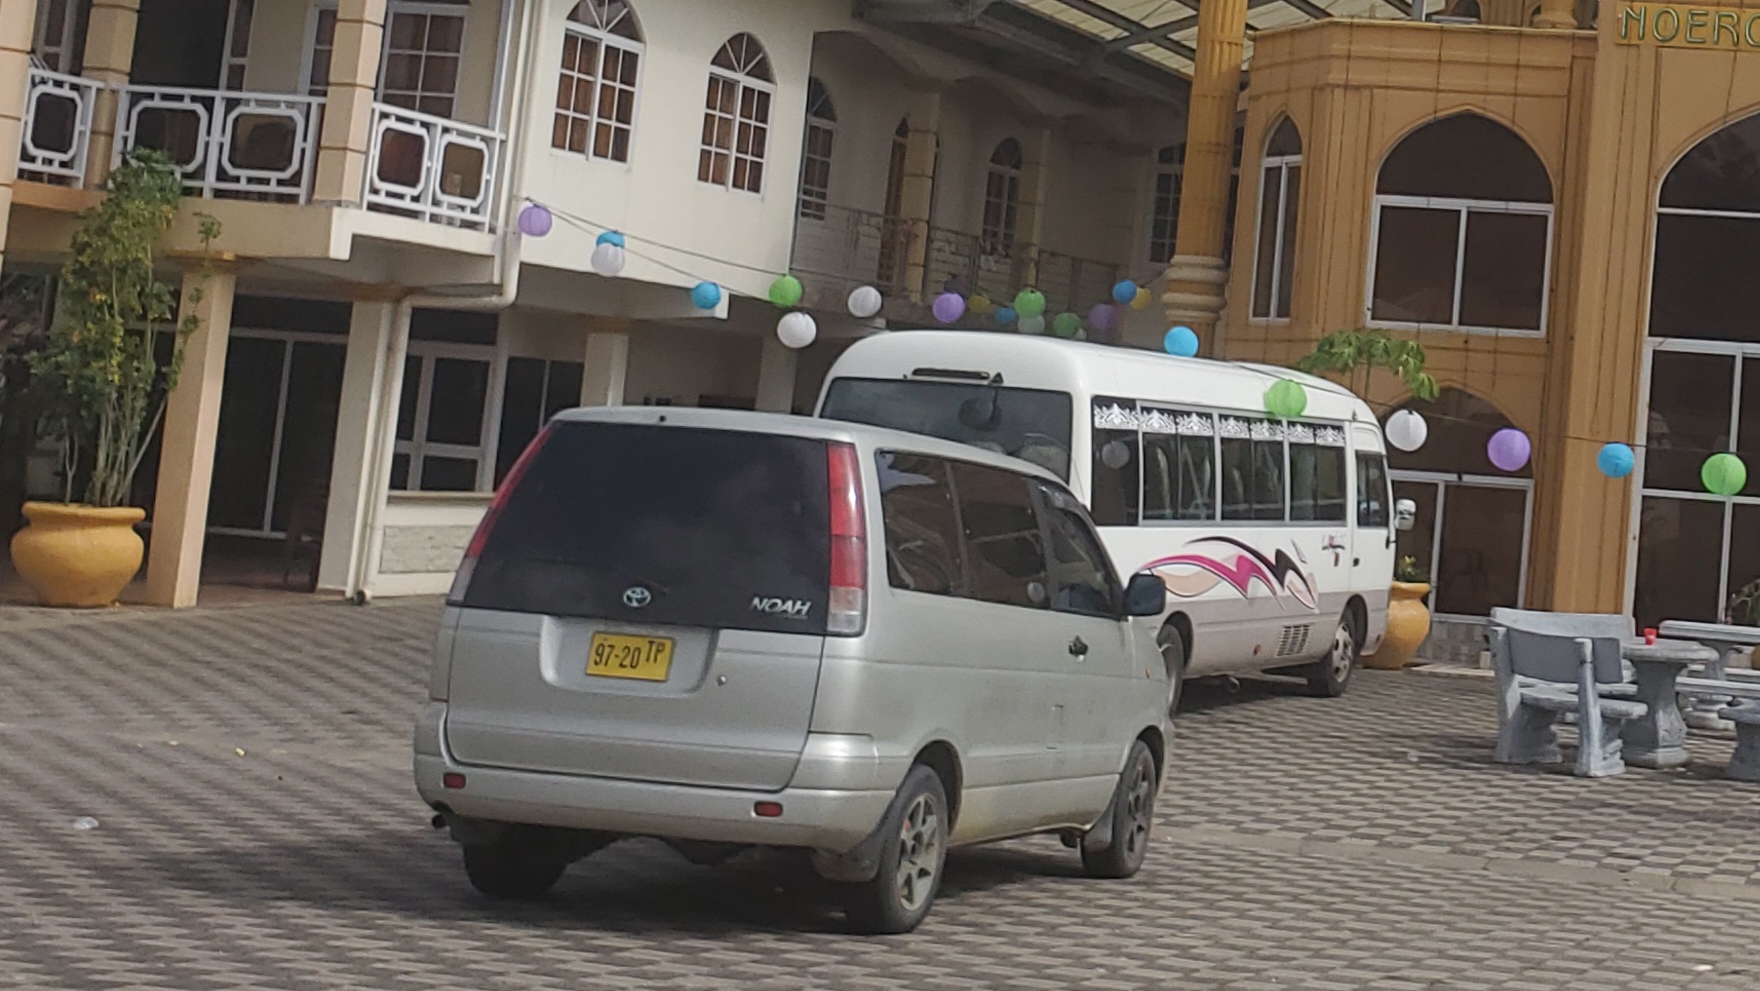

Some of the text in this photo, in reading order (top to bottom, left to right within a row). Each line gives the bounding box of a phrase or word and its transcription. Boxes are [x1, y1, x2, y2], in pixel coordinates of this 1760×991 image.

[750, 596, 811, 616] NOAH
[593, 640, 666, 670] 97-20 TP
